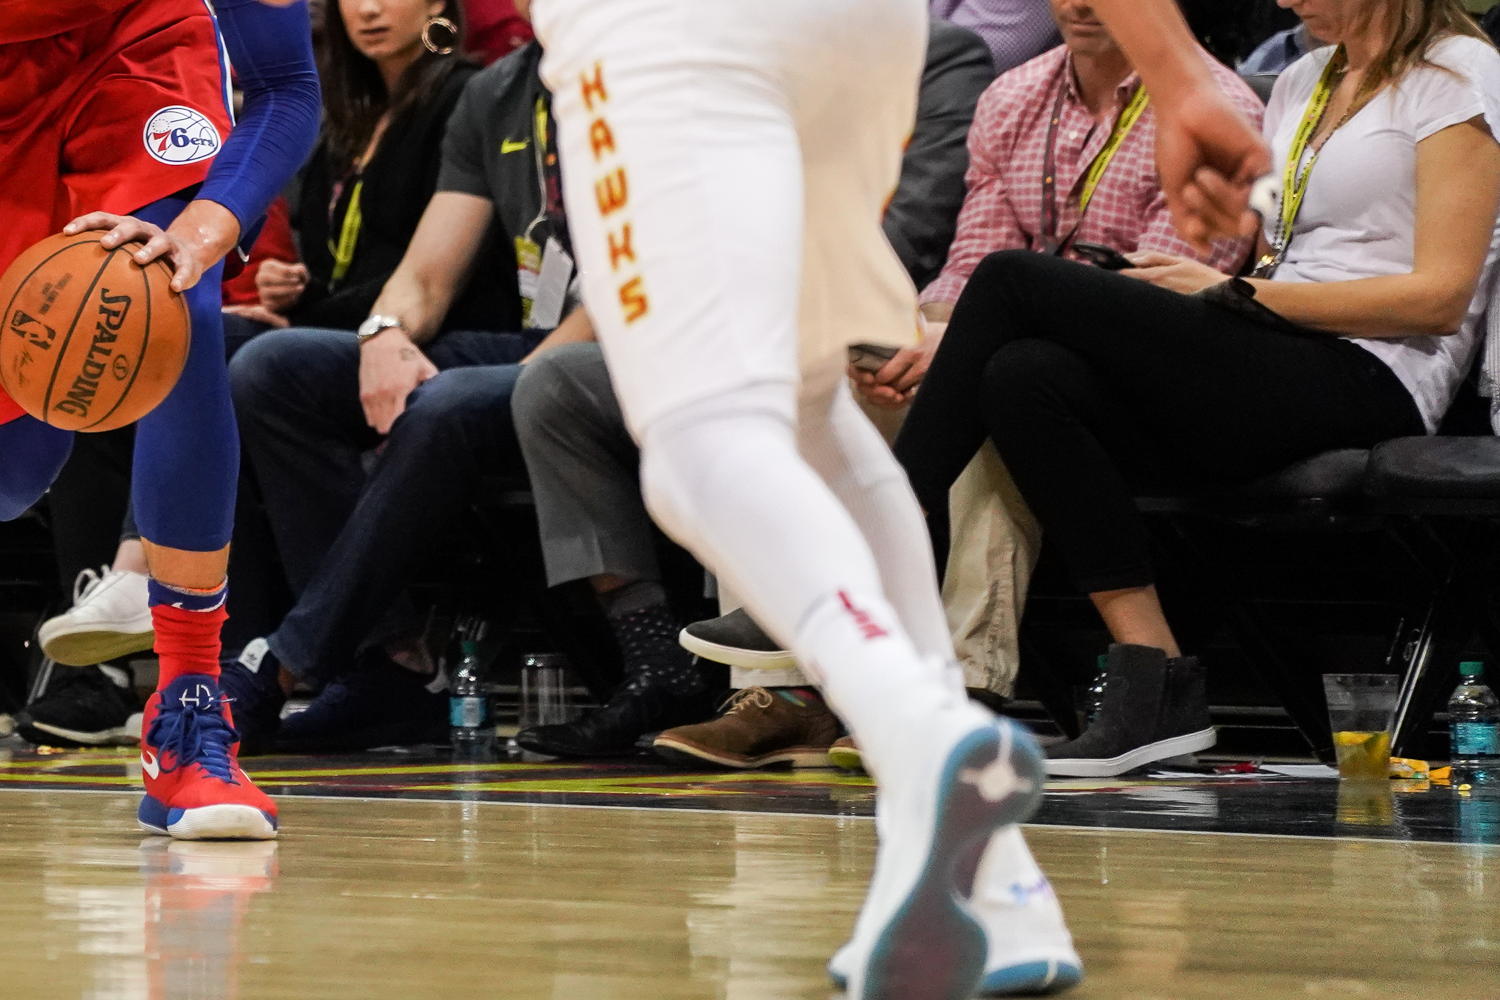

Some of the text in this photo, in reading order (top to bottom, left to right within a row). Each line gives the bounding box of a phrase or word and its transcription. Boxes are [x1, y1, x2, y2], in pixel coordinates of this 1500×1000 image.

[152, 127, 215, 153] 76ers
[579, 61, 650, 326] HAWKS
[54, 288, 132, 418] SPALDING
